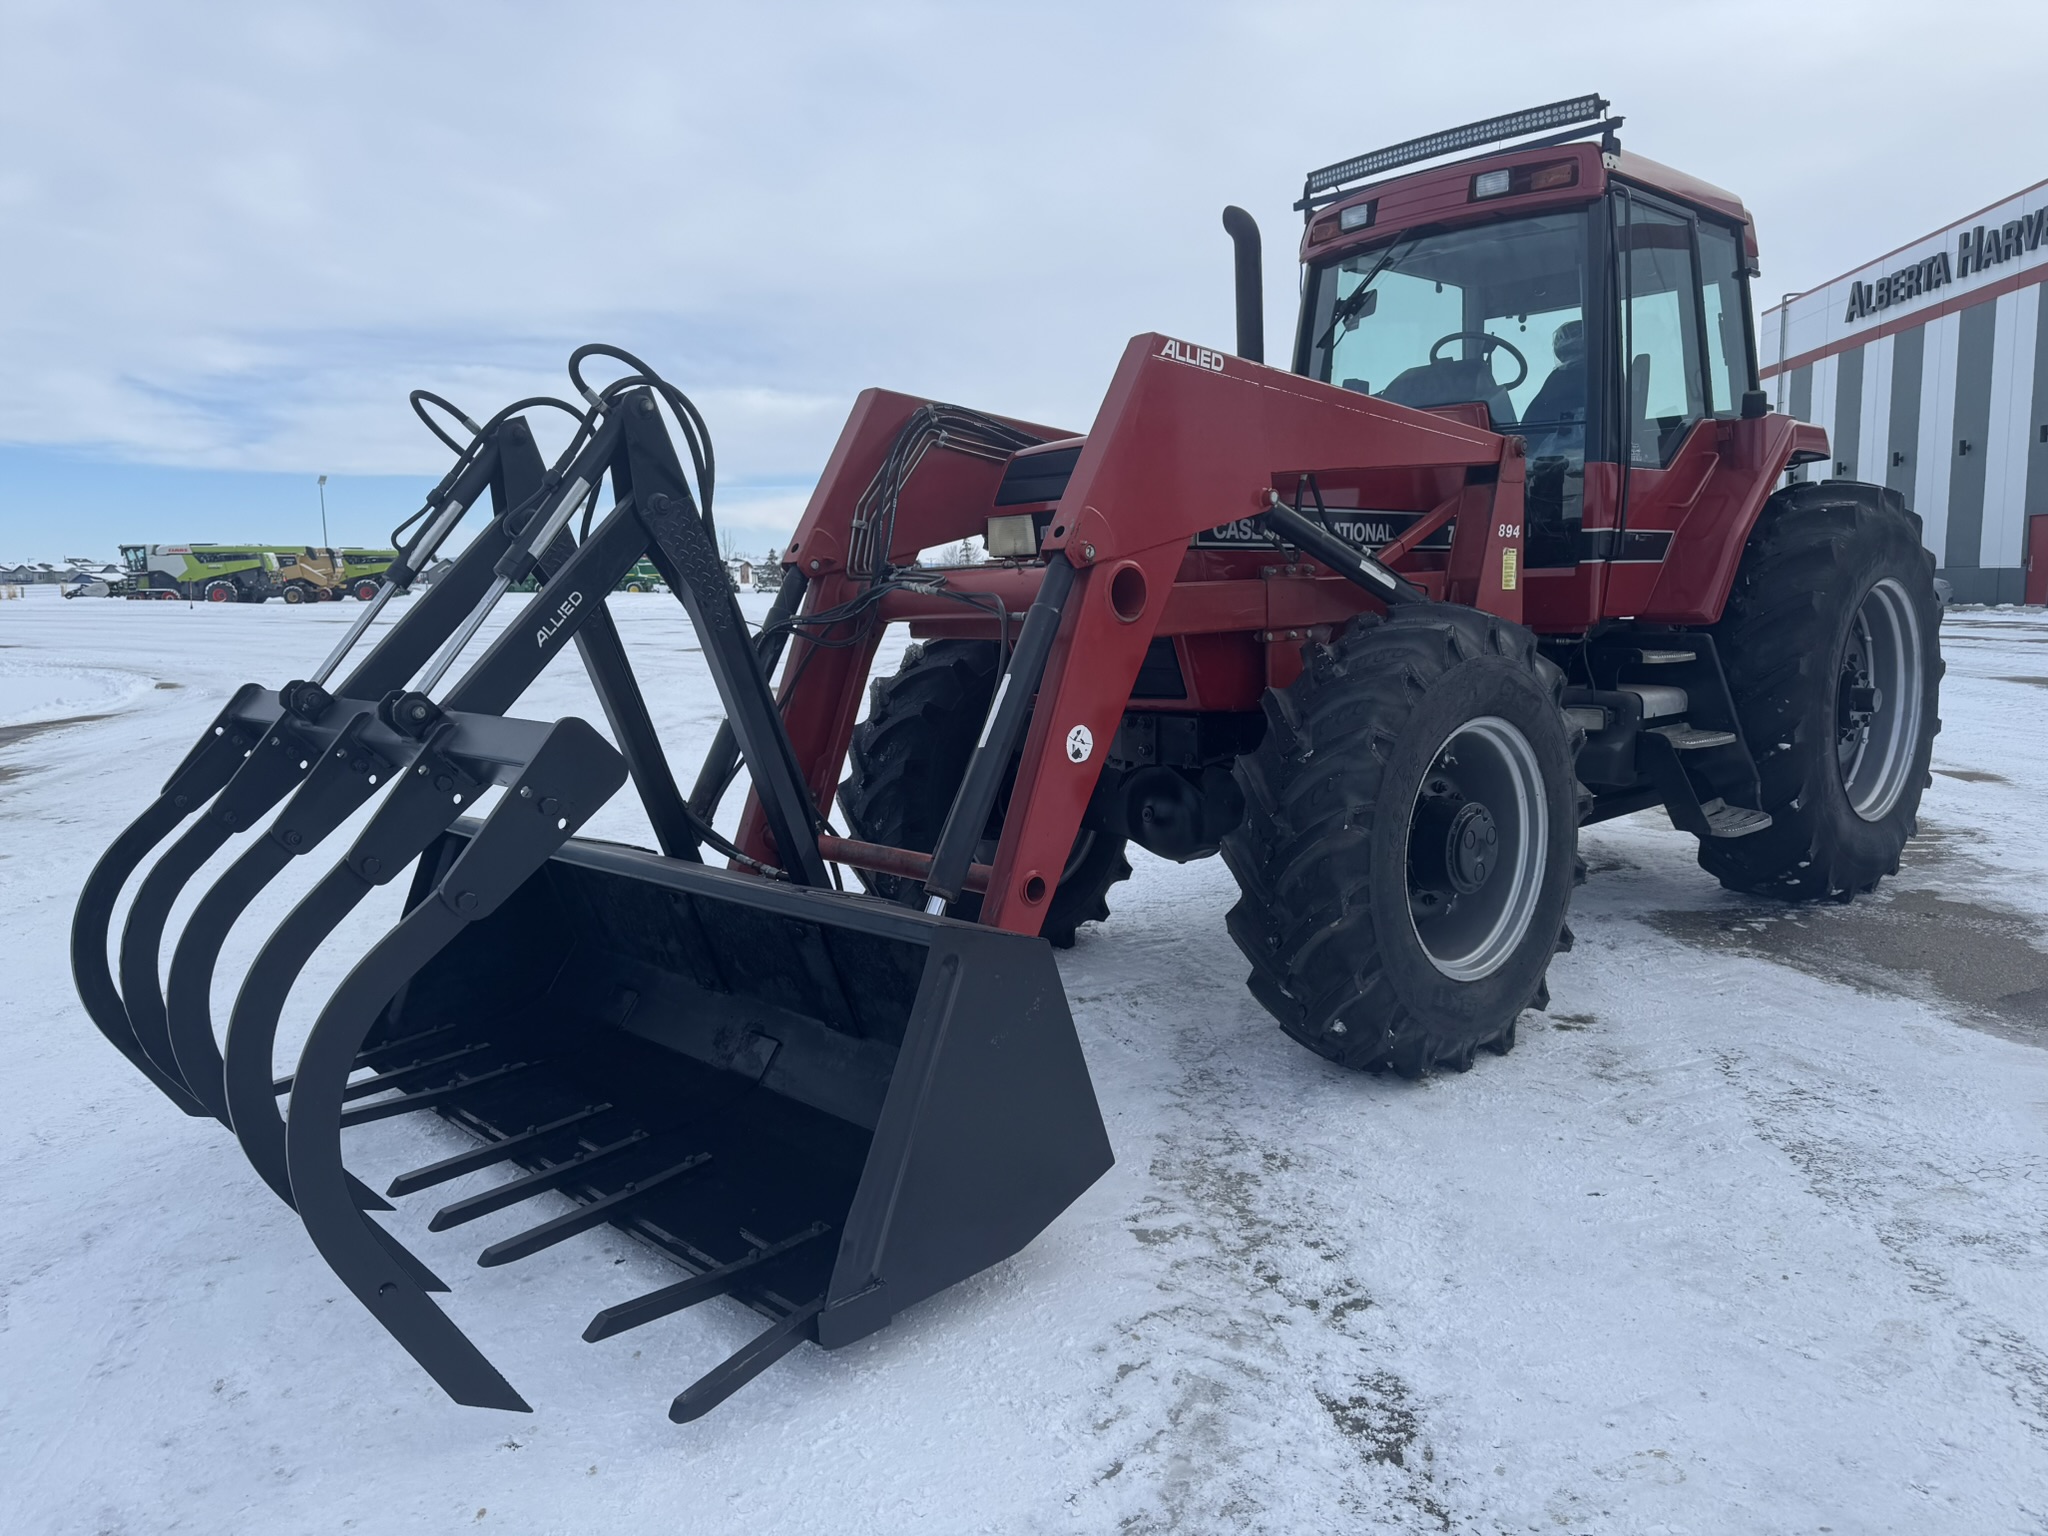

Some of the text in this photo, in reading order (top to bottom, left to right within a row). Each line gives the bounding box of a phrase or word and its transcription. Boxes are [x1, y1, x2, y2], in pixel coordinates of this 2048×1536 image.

[1845, 252, 1951, 323] ALBERTA
[1160, 339, 1225, 372] ALLIED
[1498, 523, 1520, 538] 894
[536, 591, 583, 648] ALLIED
